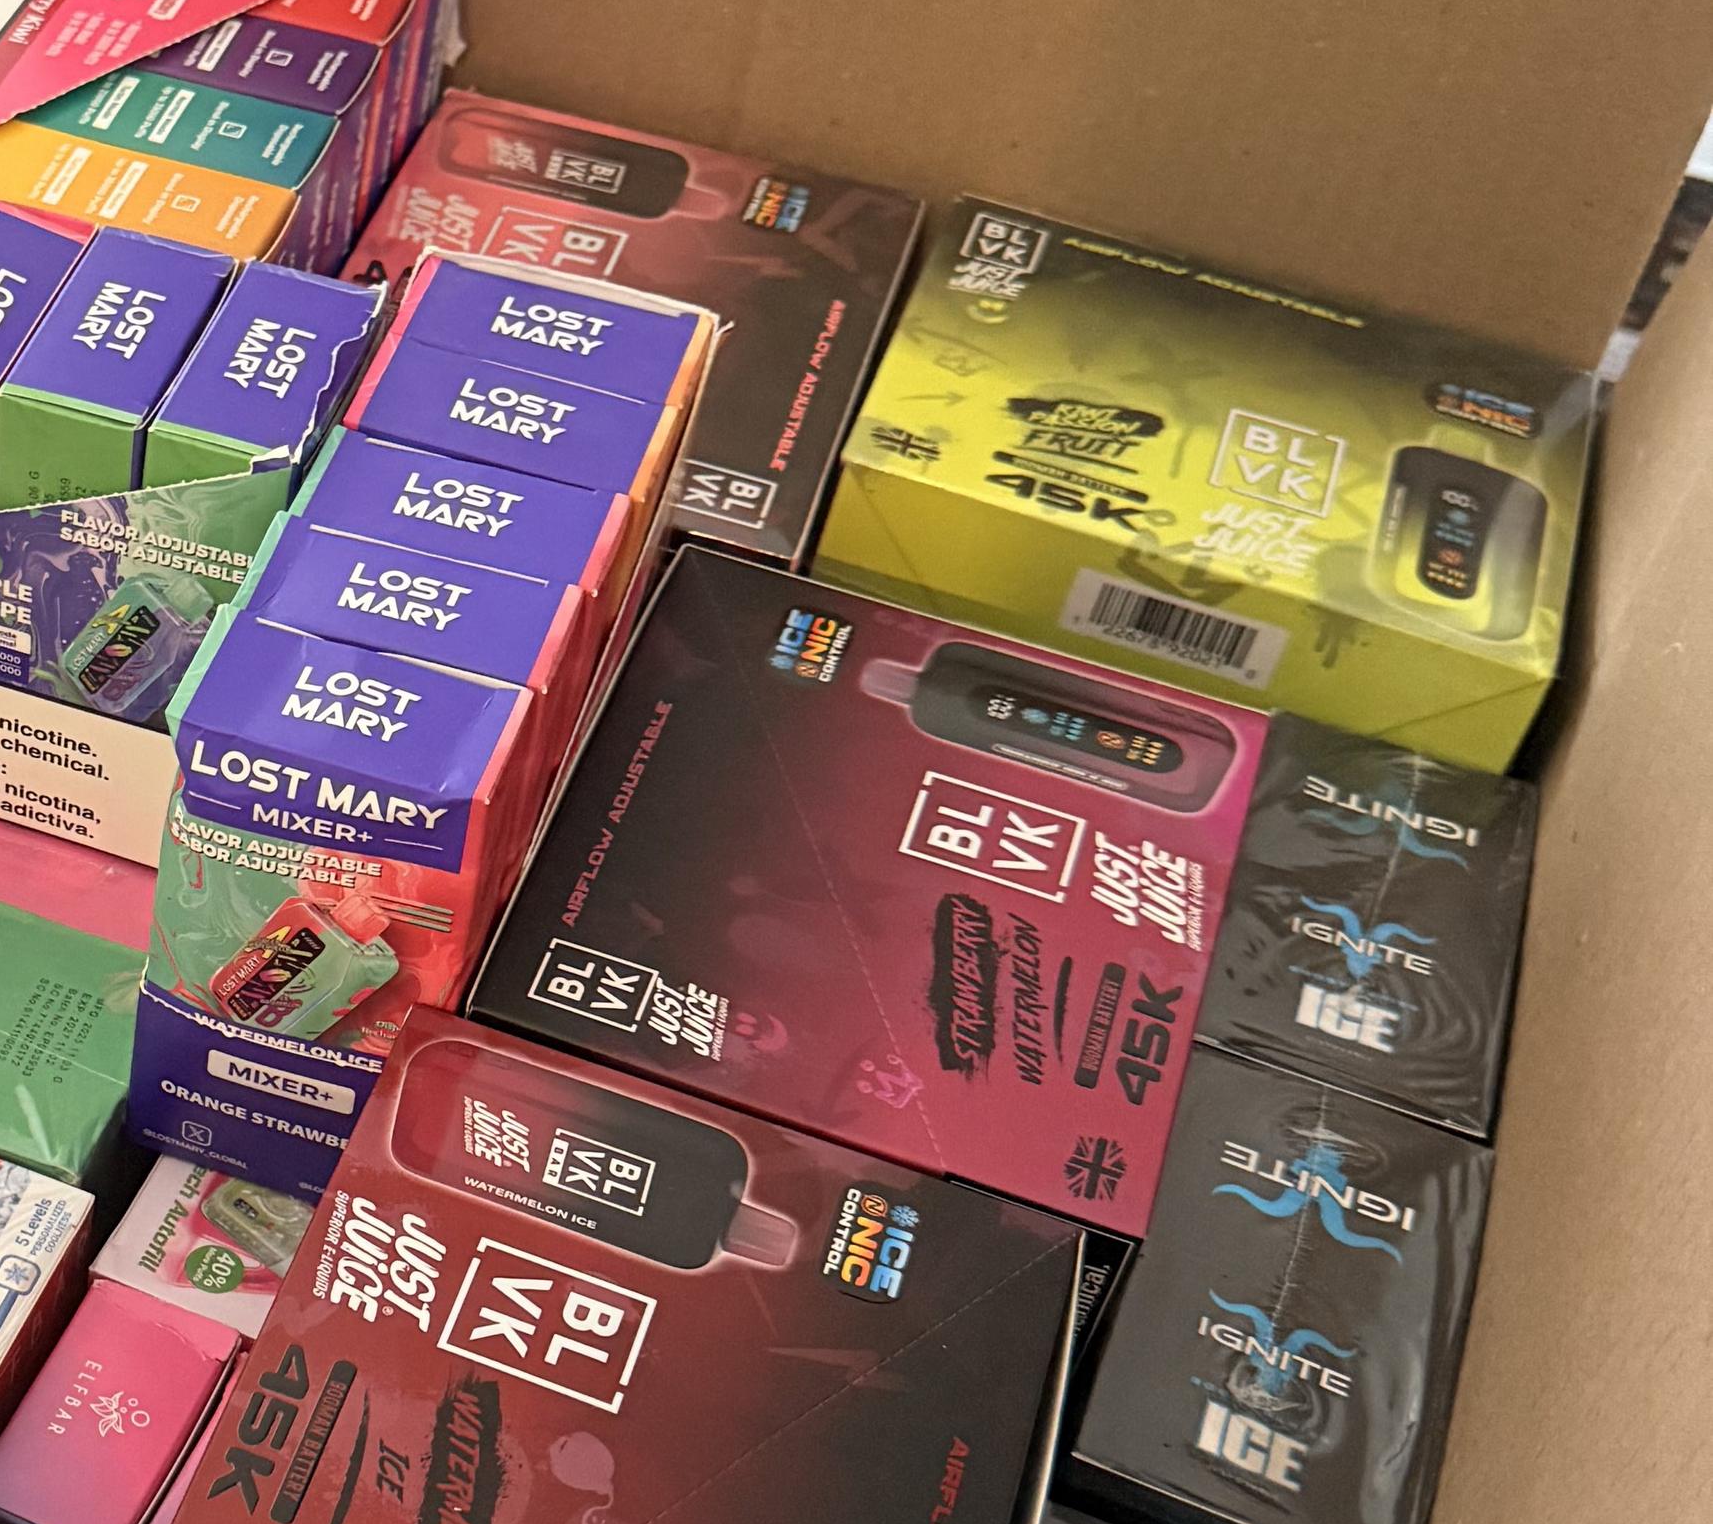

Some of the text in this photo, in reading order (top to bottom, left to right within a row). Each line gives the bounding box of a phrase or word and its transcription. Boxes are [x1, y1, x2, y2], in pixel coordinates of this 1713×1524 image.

[7, 14, 45, 45] Kiwi
[1021, 429, 1142, 458] FRUIT
[1233, 454, 1315, 501] VK
[1241, 424, 1315, 468] BL
[60, 509, 138, 542] FLAVOR
[985, 473, 1150, 532] 45K
[60, 526, 247, 585] SABOR AJUSTABLE
[281, 693, 409, 744] MARY
[294, 665, 422, 715] LOST
[0, 717, 98, 757] nicotine.
[0, 736, 110, 781] chemical.
[0, 798, 95, 839] adictiva.
[4, 781, 101, 824] nicotina,
[189, 739, 449, 831] LOST MARY
[560, 699, 674, 928] AIRFLOW ADJUSTABLE
[174, 805, 384, 877] FLAVOR ADJUSTABLE
[251, 803, 374, 844] MIXER+
[926, 787, 993, 873] BL
[992, 808, 1064, 891] VK
[234, 853, 357, 890] AJUSTABLE
[1089, 830, 1141, 927] JUST
[1138, 840, 1187, 945] JUICE
[218, 956, 261, 997] LOST MARY
[951, 897, 988, 1064] STRAWBERRY
[1290, 915, 1437, 977] IGNITE
[1007, 911, 1048, 1086] WATERMELON
[1294, 980, 1402, 1054] ICE
[194, 1012, 342, 1066] WATERMELON
[343, 1055, 383, 1074] ICE
[1115, 971, 1184, 1107] 45K
[160, 1079, 248, 1121] ORANGE
[228, 1062, 334, 1102] MIXER+
[463, 1176, 597, 1230] WATERMELON ICE
[1220, 1139, 1418, 1234] IGNITE
[138, 1201, 192, 1273] Autofill
[312, 1189, 350, 1300] SUPERIOR E-LIQUIDS
[330, 1196, 396, 1323] JUICE
[822, 1188, 862, 1276] CONTROL
[840, 1215, 885, 1287] NIC
[869, 1226, 915, 1299] ICE
[204, 1247, 237, 1293] 40%
[384, 1213, 447, 1333] JUST
[469, 1276, 554, 1359] VK
[544, 1291, 625, 1366] BL
[1197, 1314, 1357, 1399] IGNITE
[46, 1358, 104, 1437] ELFBAR
[207, 1344, 310, 1517] 45K
[375, 1437, 411, 1504] ICE
[1195, 1399, 1313, 1494] ICE
